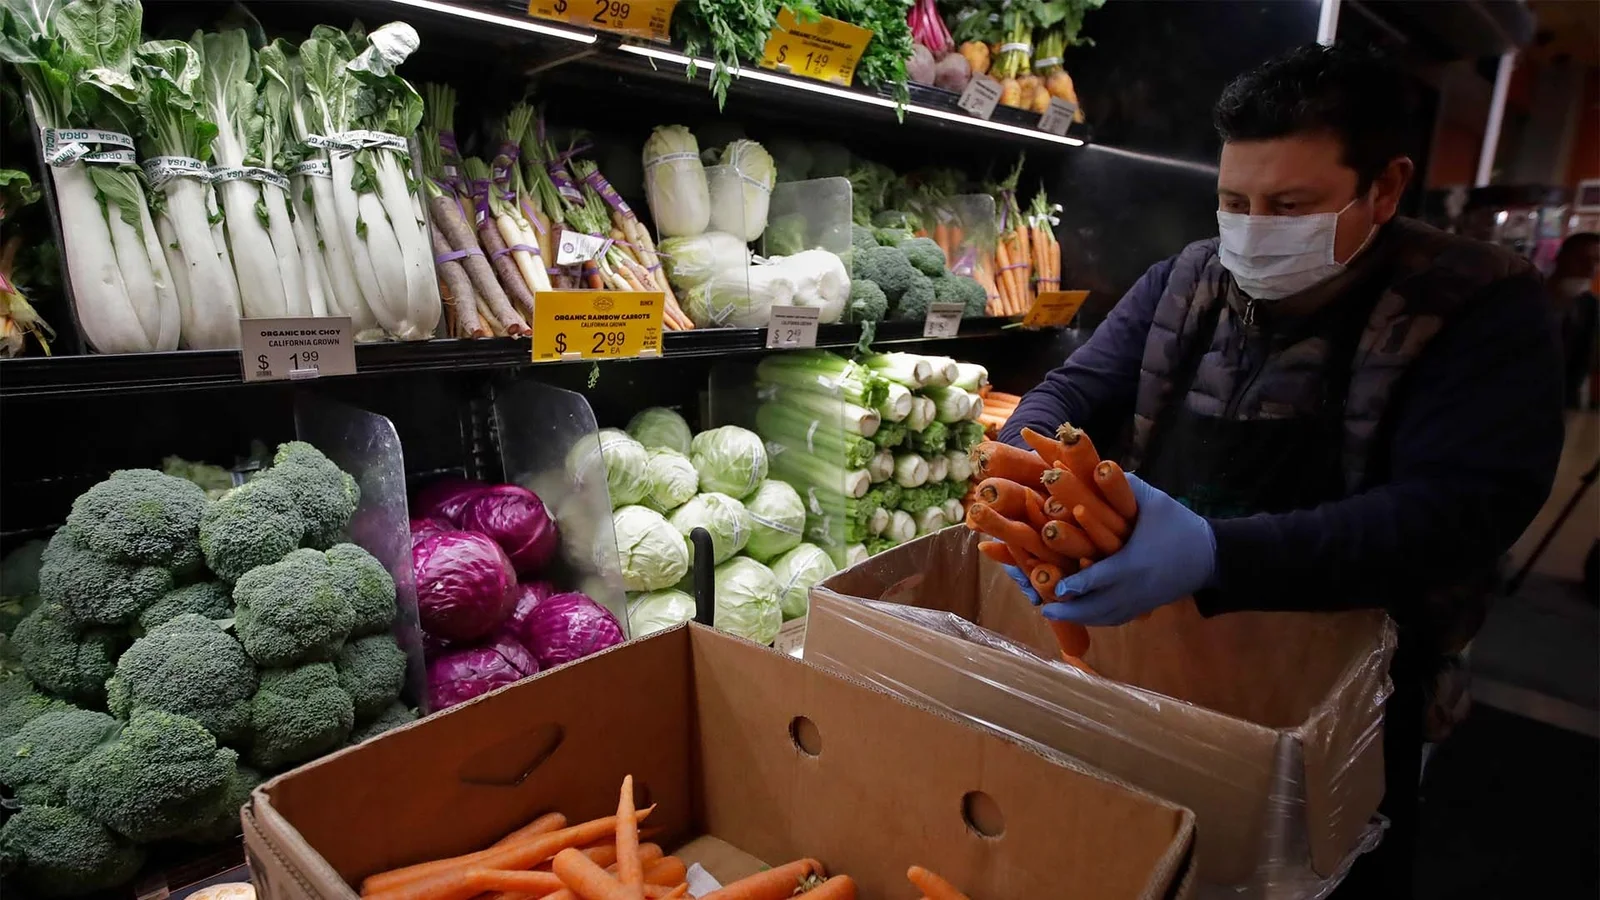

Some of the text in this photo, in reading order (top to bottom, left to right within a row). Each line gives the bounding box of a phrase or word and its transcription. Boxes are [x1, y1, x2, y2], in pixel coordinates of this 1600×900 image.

[98, 132, 118, 142] USA
[166, 158, 186, 167] USA
[268, 338, 340, 348] CALIFORNIA GROWN
[555, 332, 567, 354] $
[258, 354, 269, 370] $
